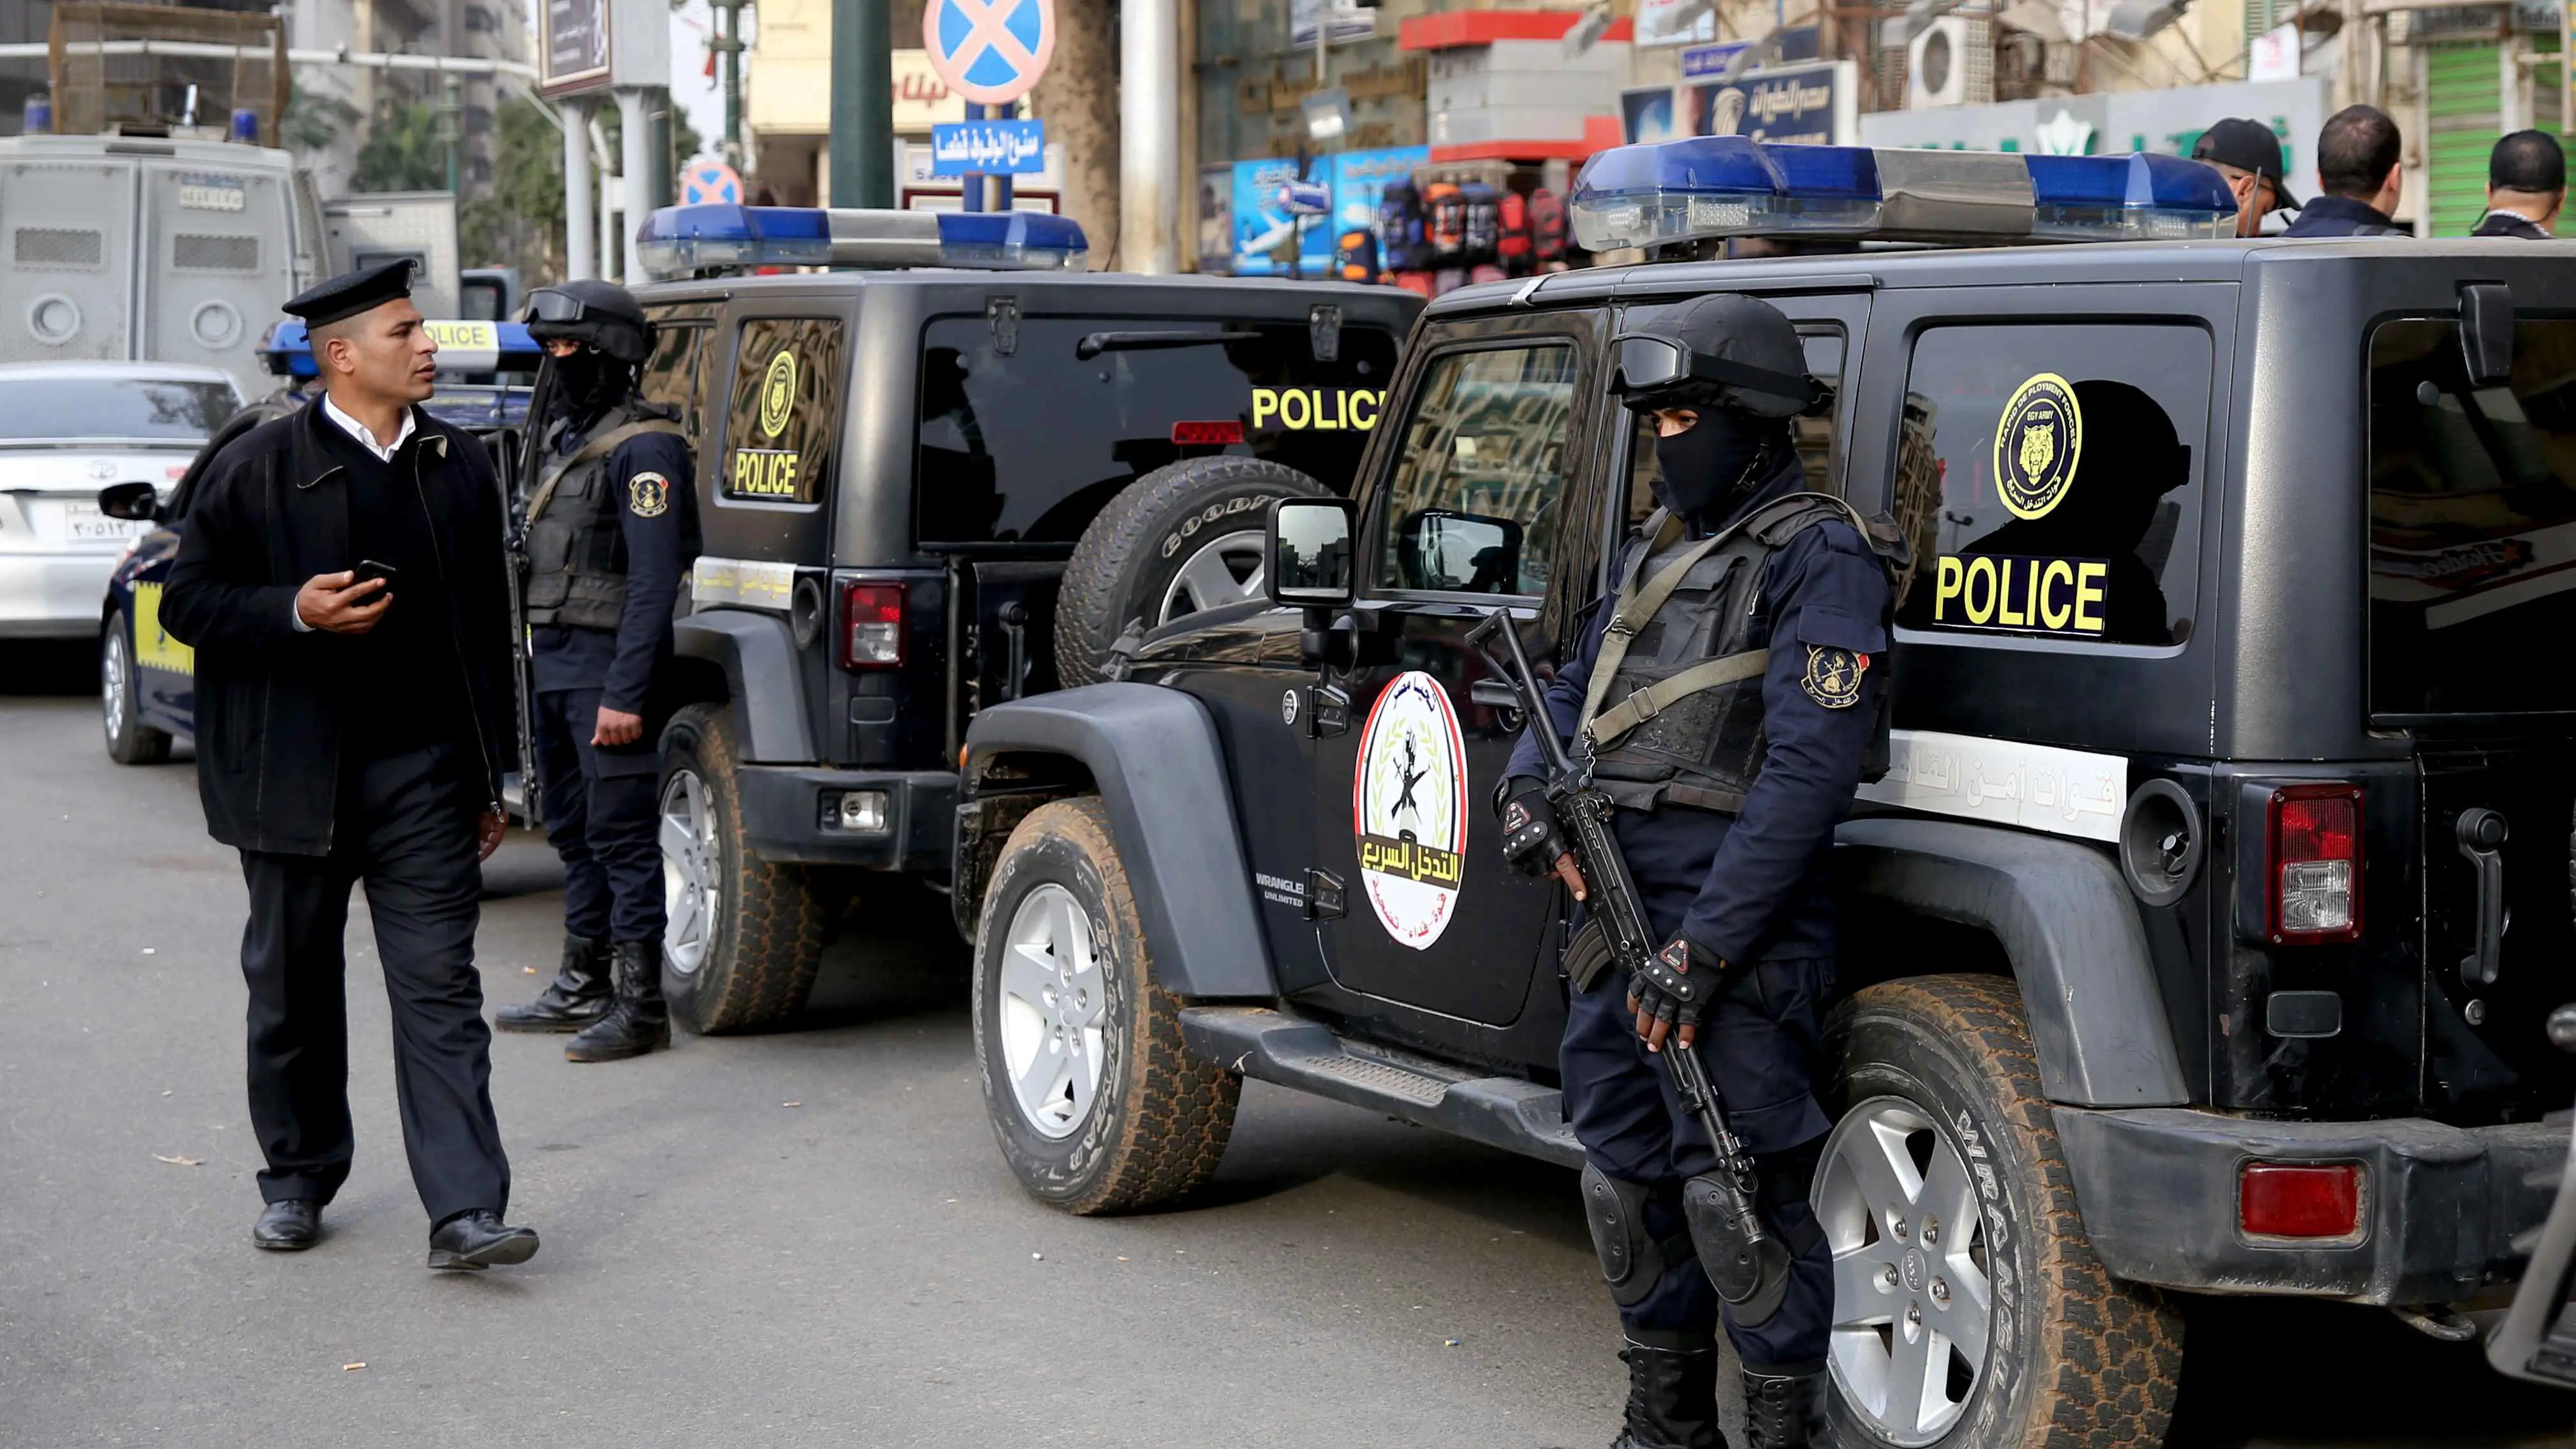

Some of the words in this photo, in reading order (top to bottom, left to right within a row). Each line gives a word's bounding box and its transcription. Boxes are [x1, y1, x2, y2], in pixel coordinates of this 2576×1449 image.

[423, 326, 486, 344] OLICE
[1251, 388, 1386, 430] POLIC
[2028, 411, 2039, 421] EGY
[2038, 410, 2054, 420] ARMY
[2061, 396, 2076, 449] FORCES
[735, 453, 798, 494] POLICE
[1162, 495, 1277, 558] GOOD
[1935, 555, 2107, 630] POLICE
[1393, 680, 1411, 710] مصر
[2033, 765, 2117, 822] قوات
[1362, 841, 1409, 872] السريع
[1411, 845, 1458, 882] التدخل
[1264, 891, 1304, 908] UNLIMITED
